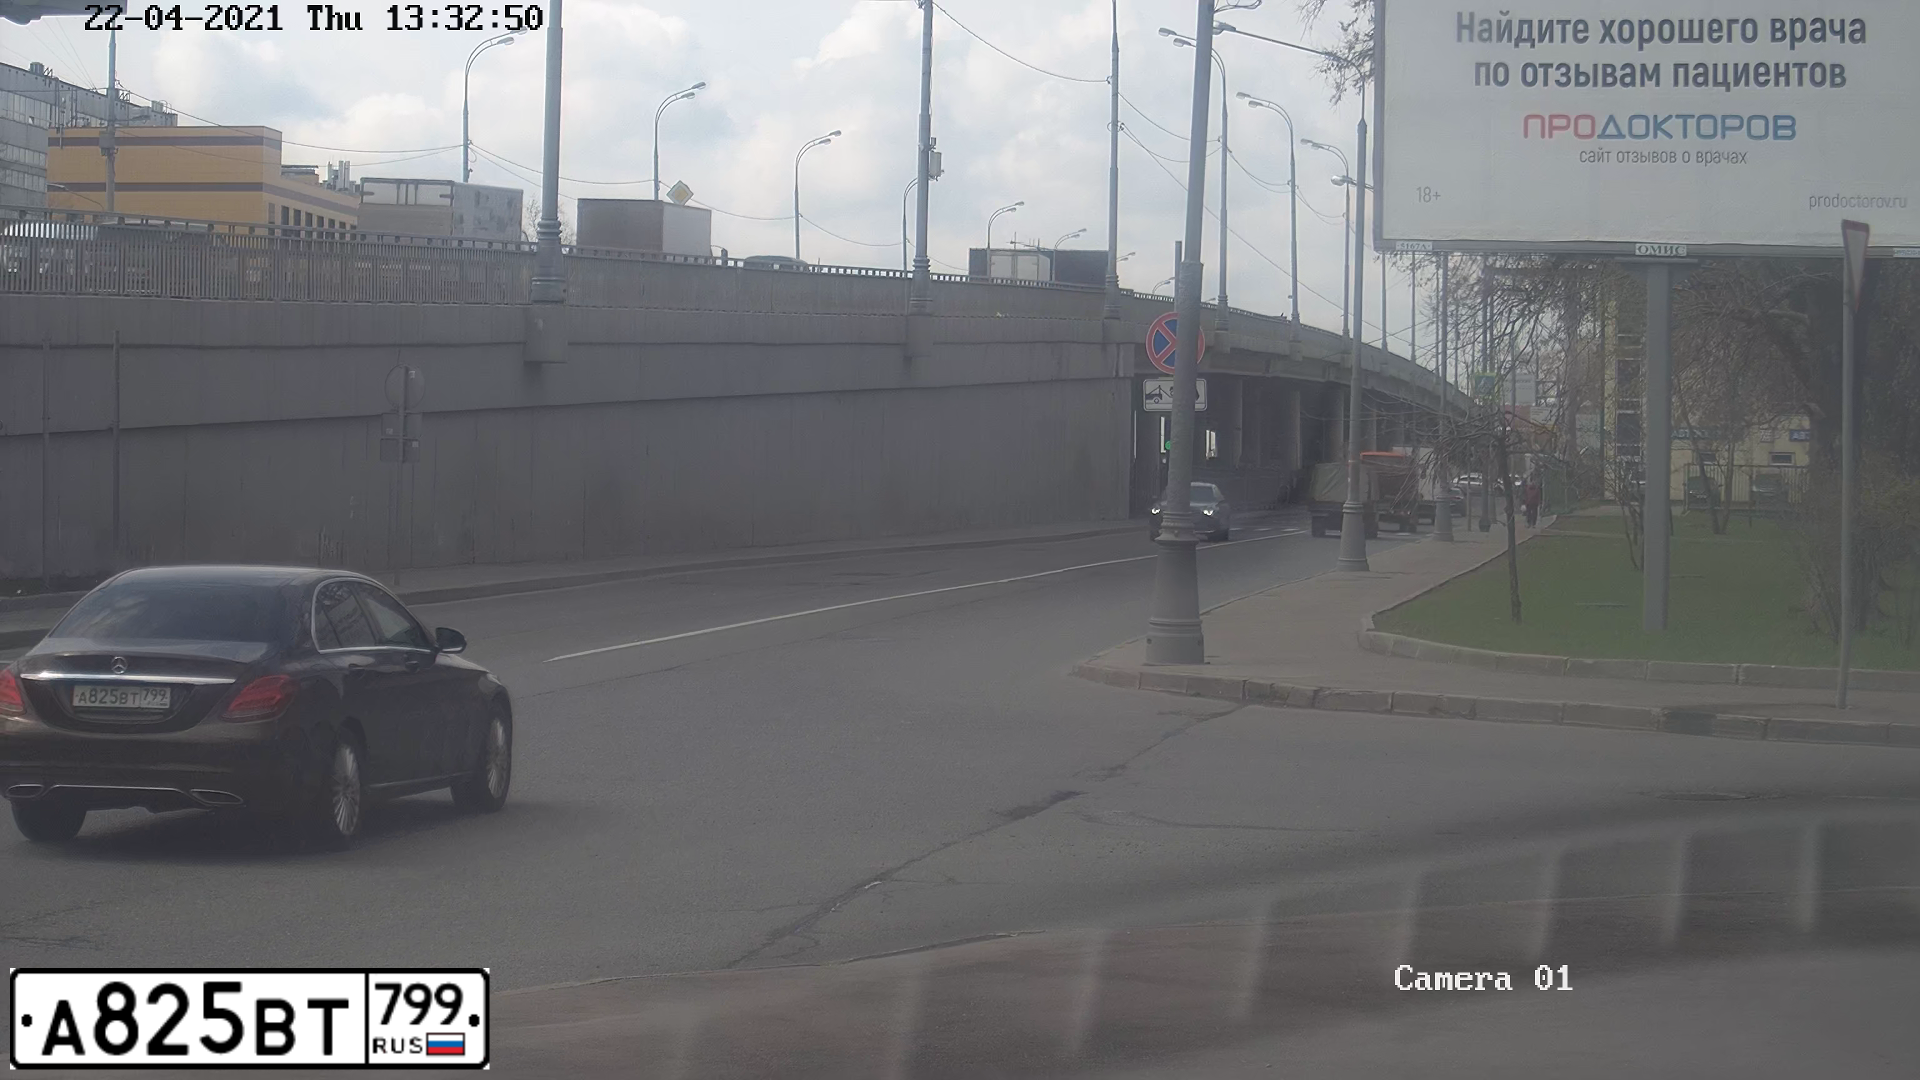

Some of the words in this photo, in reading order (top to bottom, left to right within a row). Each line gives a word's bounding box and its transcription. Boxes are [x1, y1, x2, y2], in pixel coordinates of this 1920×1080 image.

[1456, 11, 1590, 48] Найдите
[1598, 17, 1759, 51] хорошего
[1769, 16, 1867, 50] врача
[1474, 62, 1510, 88] по
[1520, 61, 1661, 88] отзывам
[1671, 61, 1847, 92] пациентов
[1523, 114, 1797, 141] ПРОДОКТОРОВ
[1579, 147, 1612, 164] сайт
[1616, 151, 1677, 164] отзывов
[1682, 151, 1691, 163] о
[1695, 150, 1748, 168] врачах
[1415, 187, 1441, 203] 18+
[1808, 192, 1908, 211] prodoctorov.ru
[1637, 244, 1686, 255] ОМИС
[143, 688, 168, 702] 799
